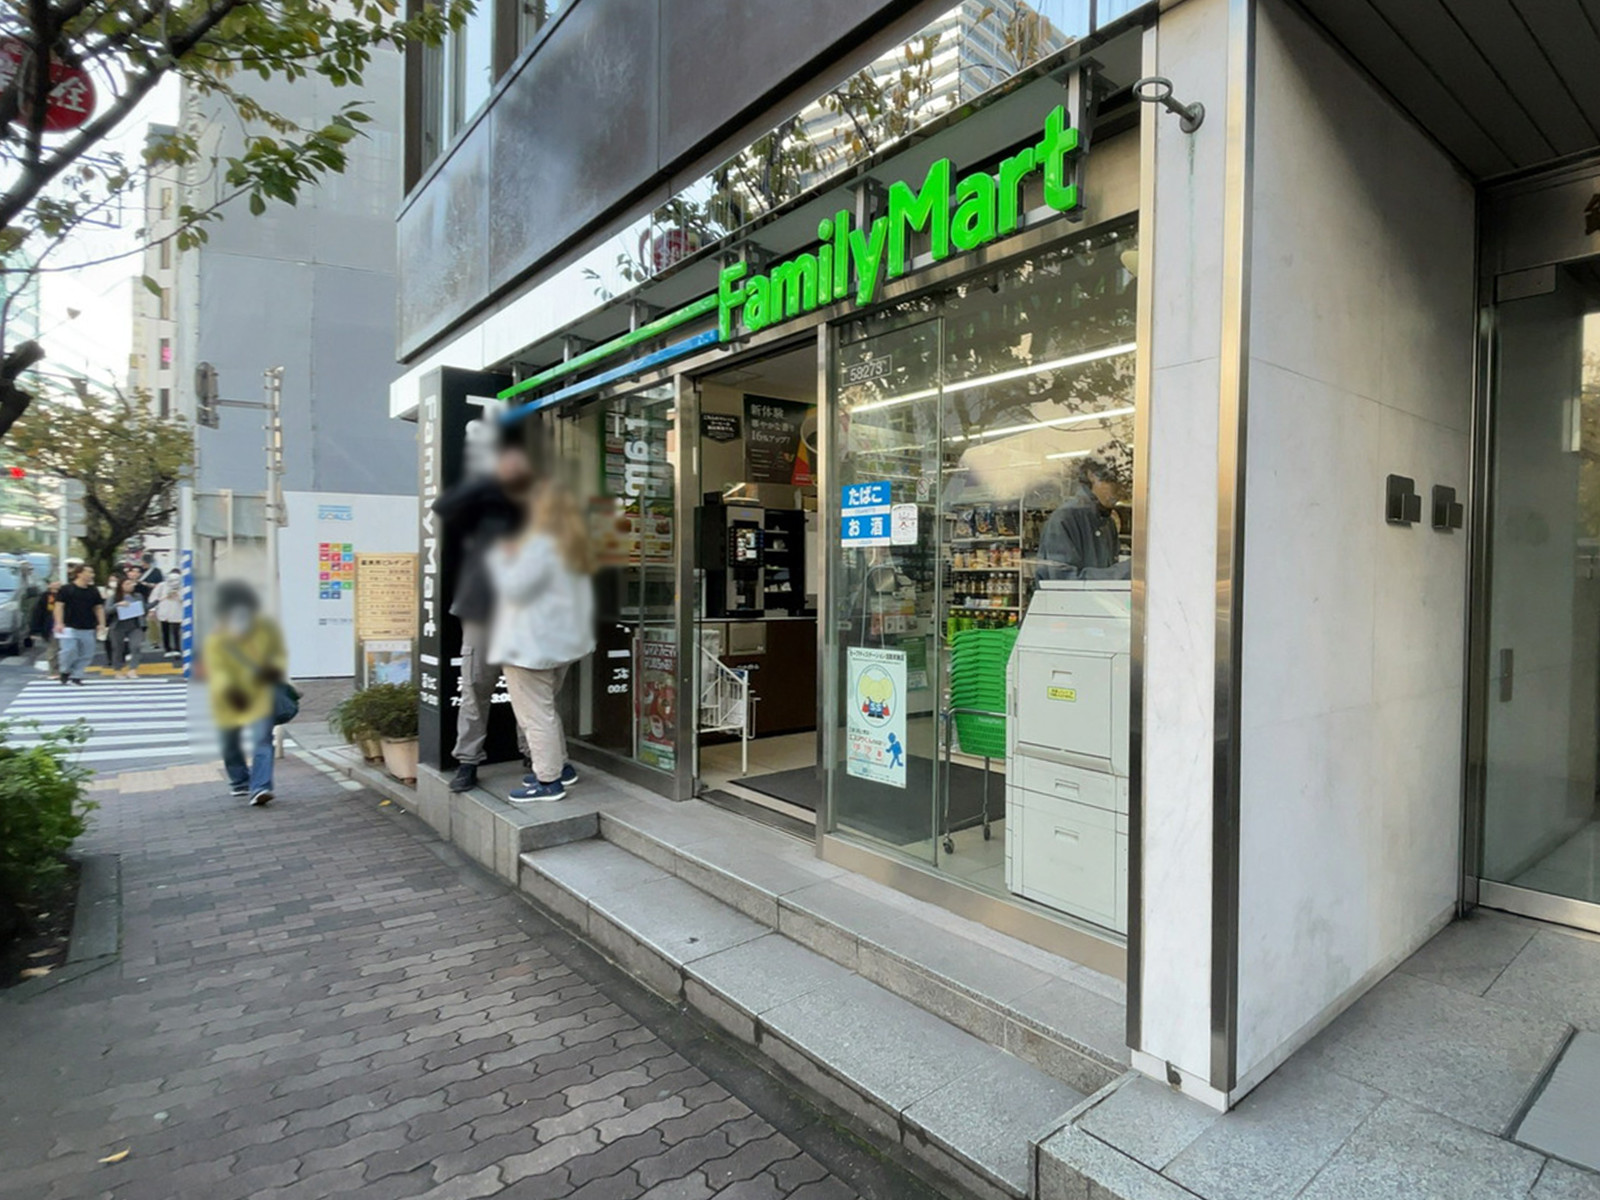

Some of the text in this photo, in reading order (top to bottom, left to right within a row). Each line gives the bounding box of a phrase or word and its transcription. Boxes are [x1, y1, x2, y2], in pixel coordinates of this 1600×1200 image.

[719, 104, 1079, 343] FamilyMart
[848, 485, 883, 505] たばこ
[848, 517, 884, 537] お酒
